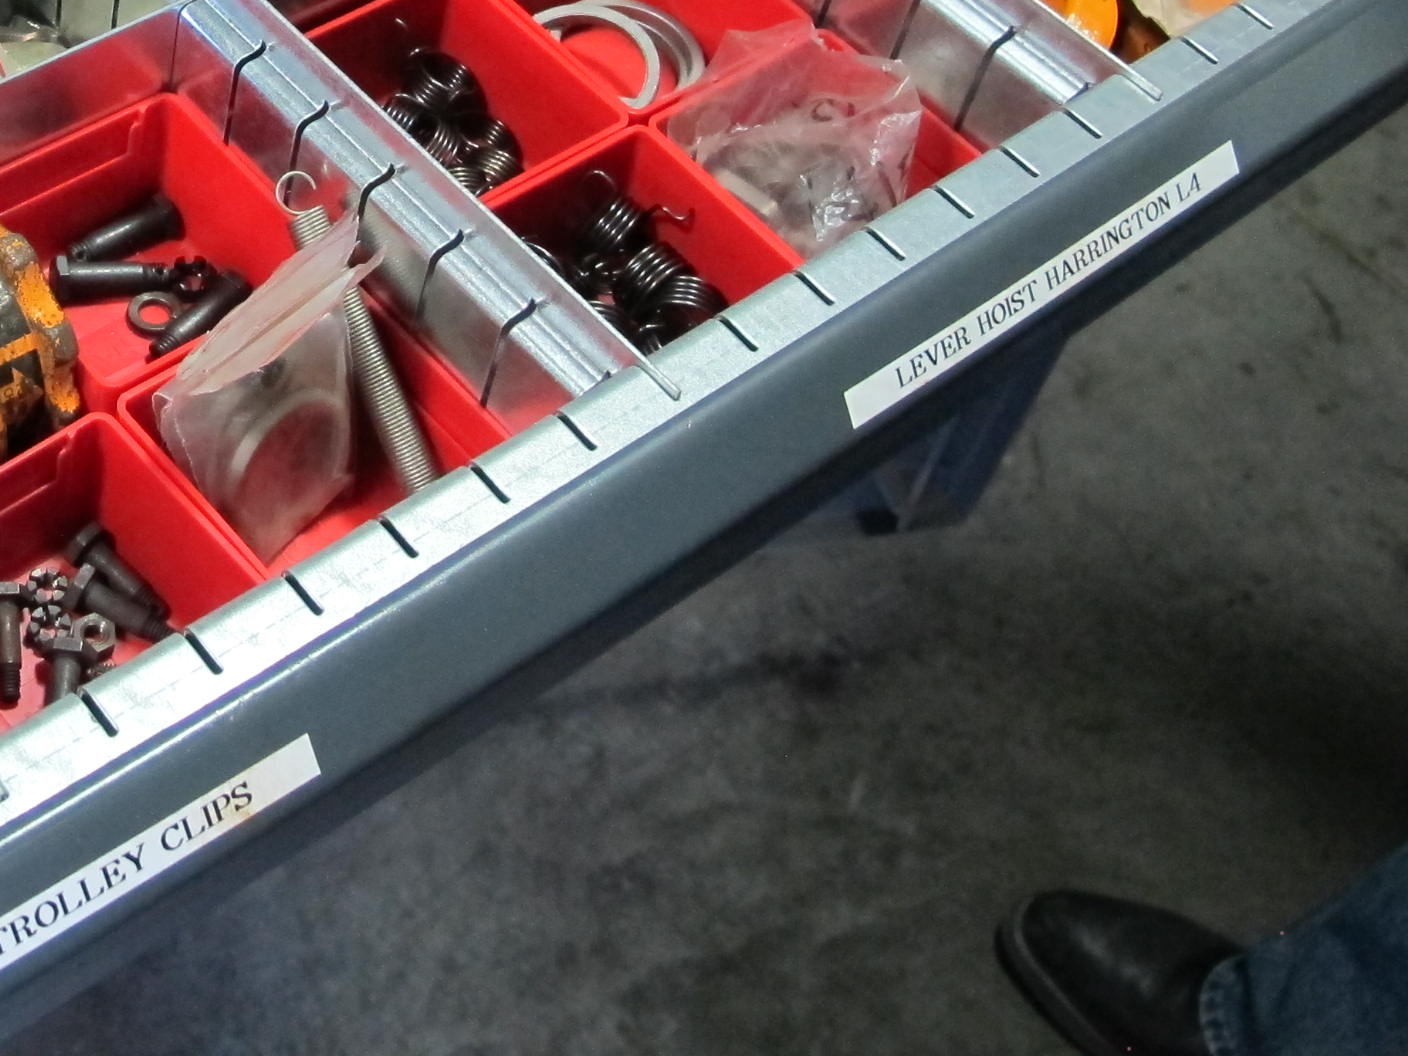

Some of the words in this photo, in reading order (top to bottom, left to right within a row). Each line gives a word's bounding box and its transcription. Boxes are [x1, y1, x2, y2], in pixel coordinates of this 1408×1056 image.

[896, 327, 972, 389] LEVER
[977, 279, 1039, 336] HOIST
[1045, 192, 1172, 291] HARRINGTON
[160, 780, 254, 853] CLIPS
